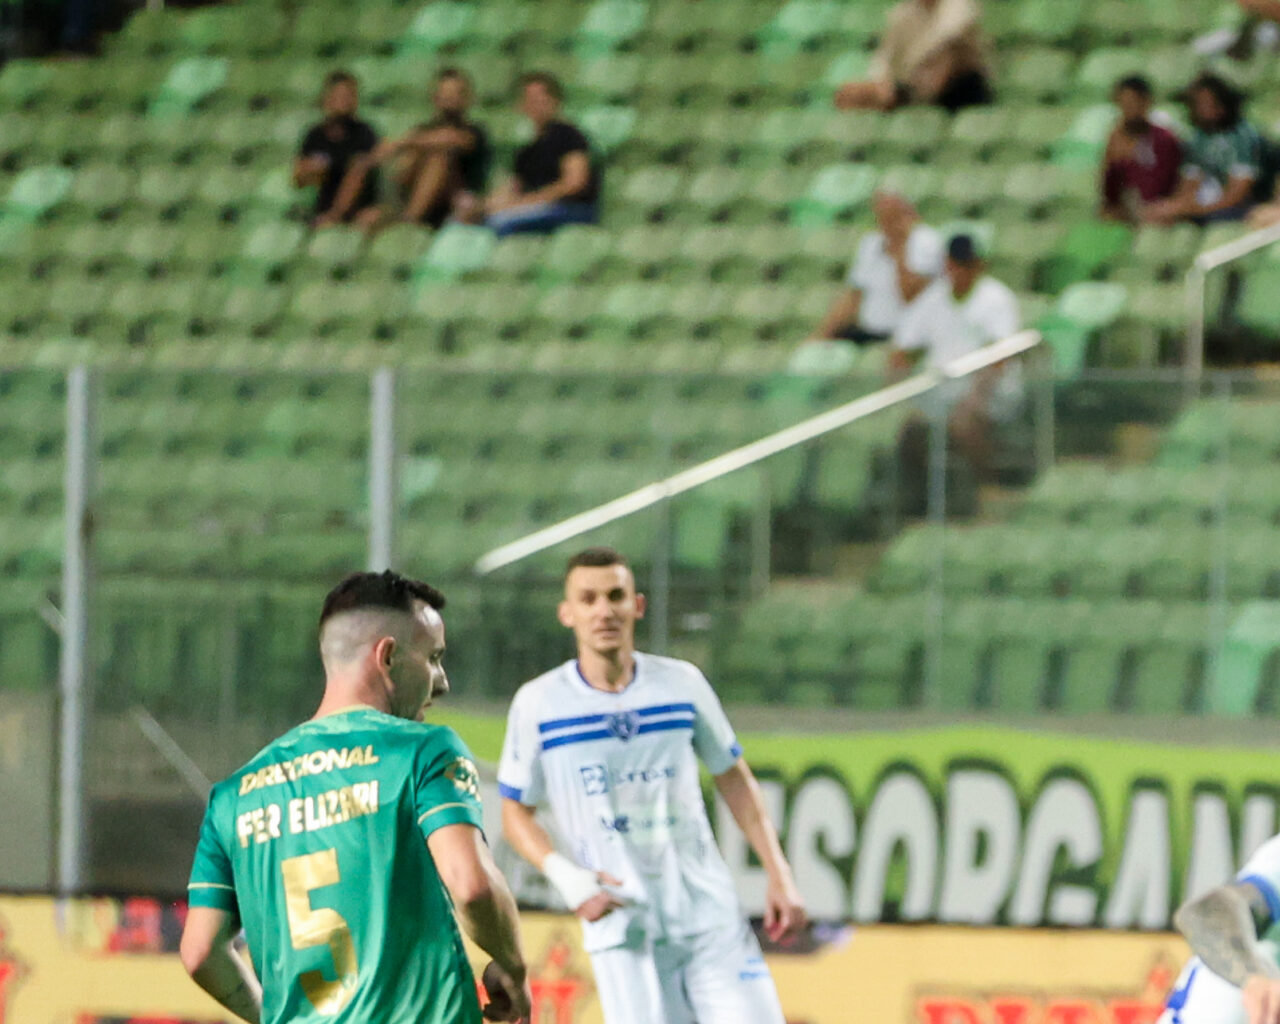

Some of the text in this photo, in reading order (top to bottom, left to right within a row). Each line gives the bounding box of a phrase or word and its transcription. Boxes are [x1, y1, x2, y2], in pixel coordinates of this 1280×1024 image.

[236, 779, 380, 850] FER ELIZARI
[281, 847, 358, 1017] 5
